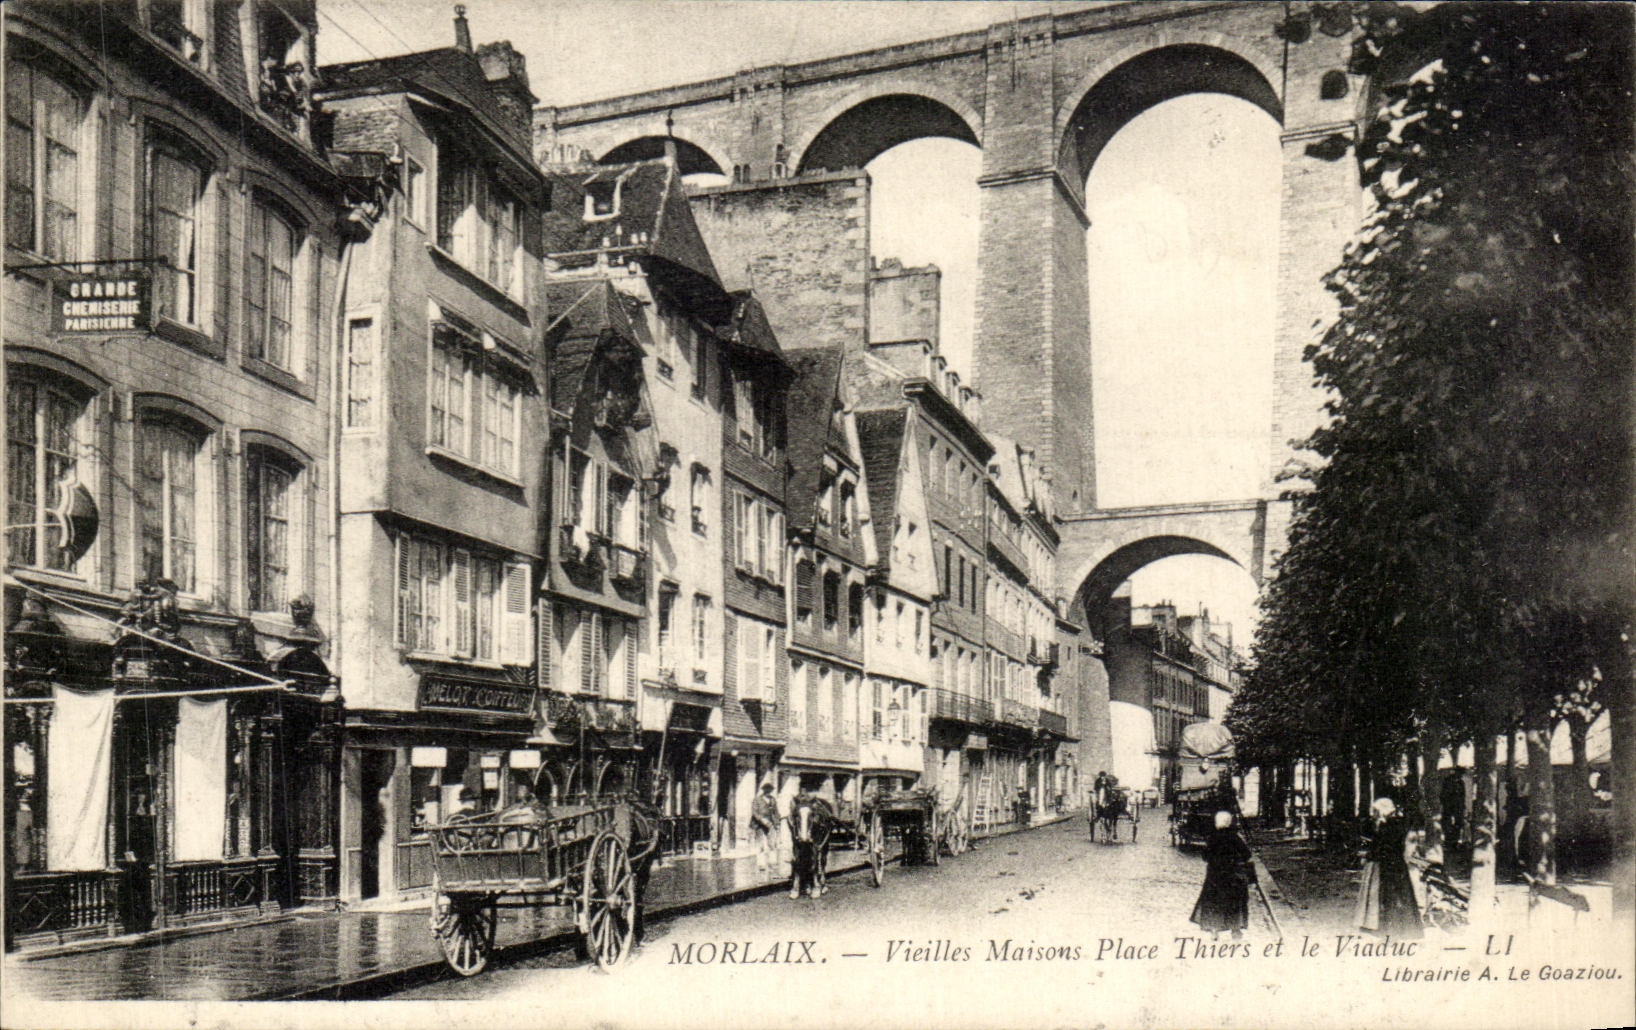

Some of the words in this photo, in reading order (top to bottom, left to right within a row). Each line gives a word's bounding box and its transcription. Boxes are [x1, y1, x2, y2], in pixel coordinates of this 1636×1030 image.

[70, 281, 137, 298] GRANDE
[63, 300, 141, 316] CHEMISERIE
[65, 316, 136, 331] PARISIENNE
